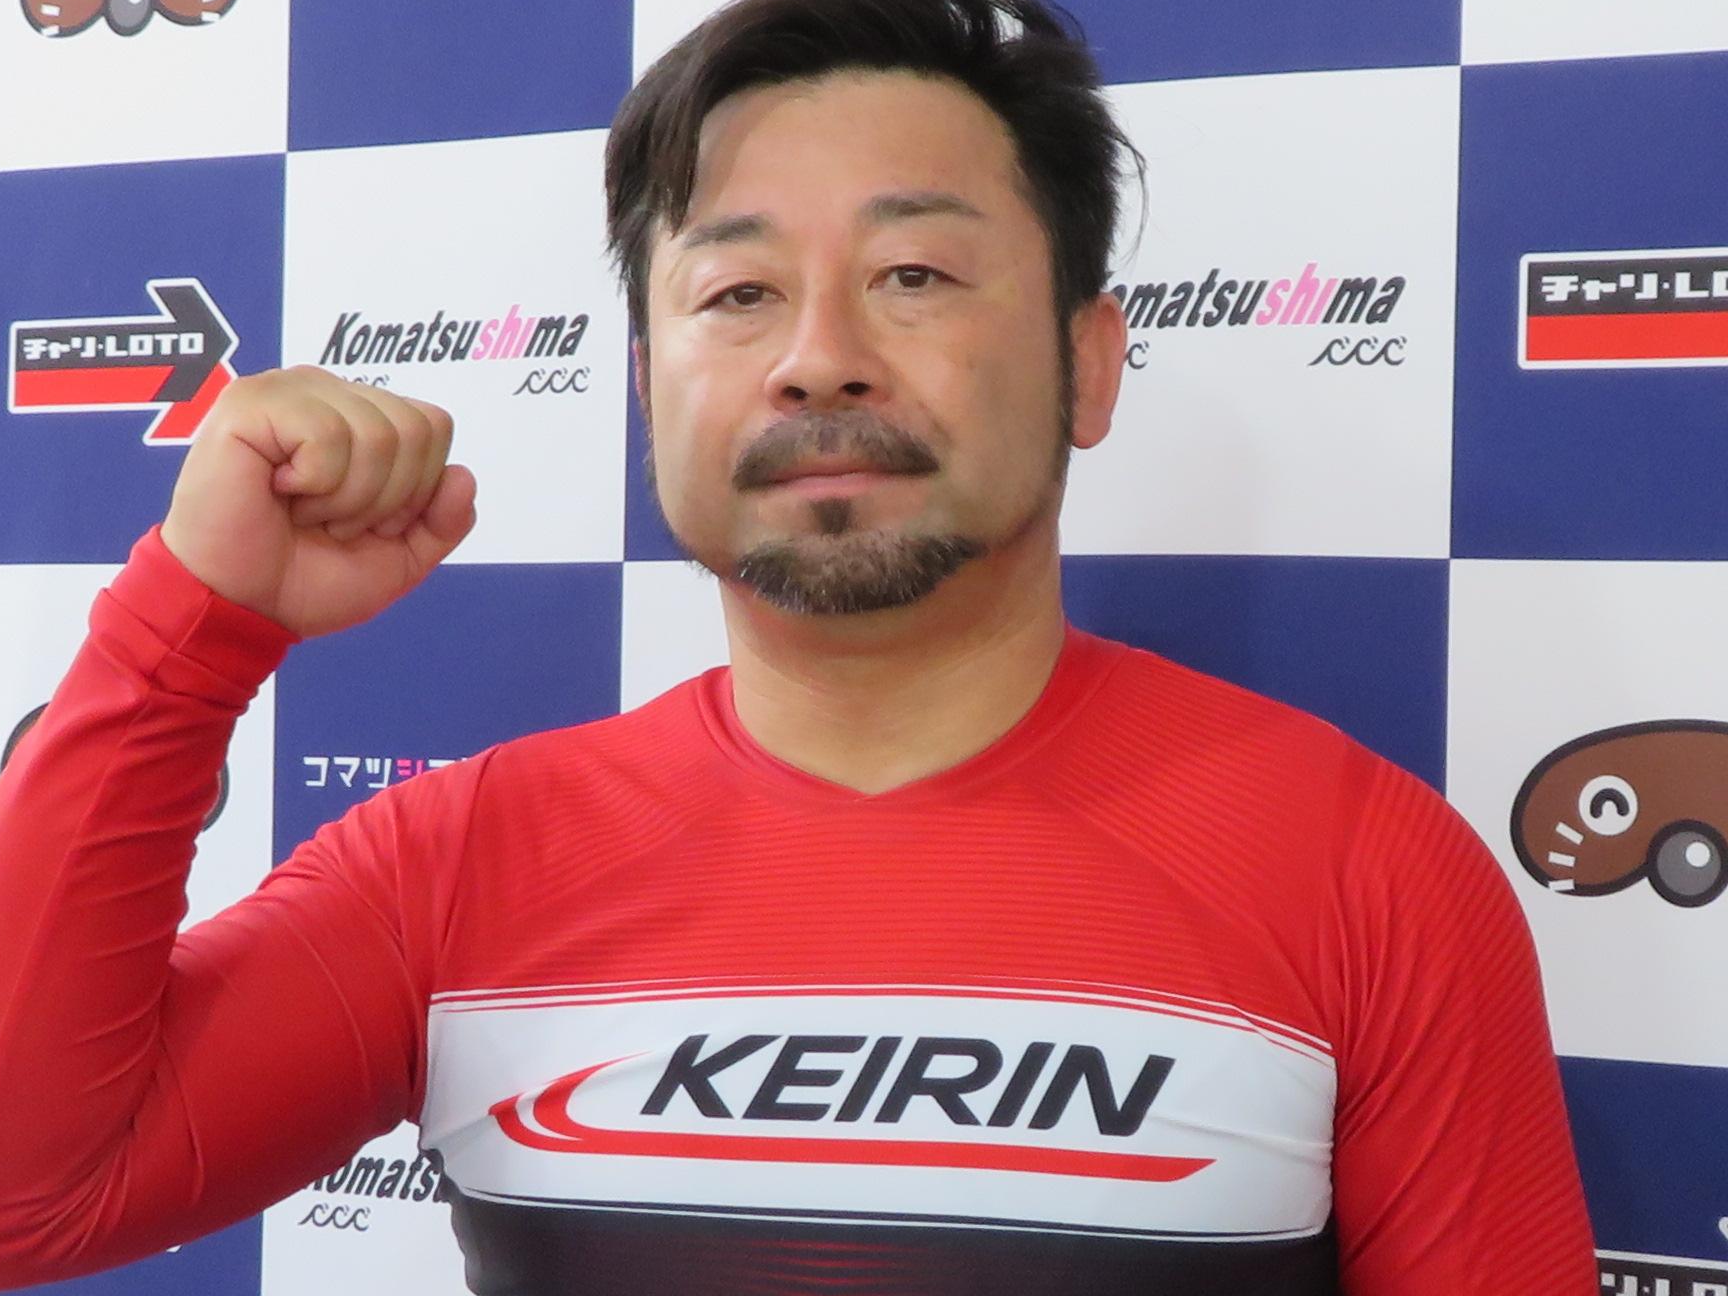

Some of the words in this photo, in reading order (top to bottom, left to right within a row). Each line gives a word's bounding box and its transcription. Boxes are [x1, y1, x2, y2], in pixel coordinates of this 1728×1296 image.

[1110, 264, 1406, 330] matsushima
[320, 306, 589, 366] Komatsushima
[640, 1034, 1176, 1137] KEIRIN
